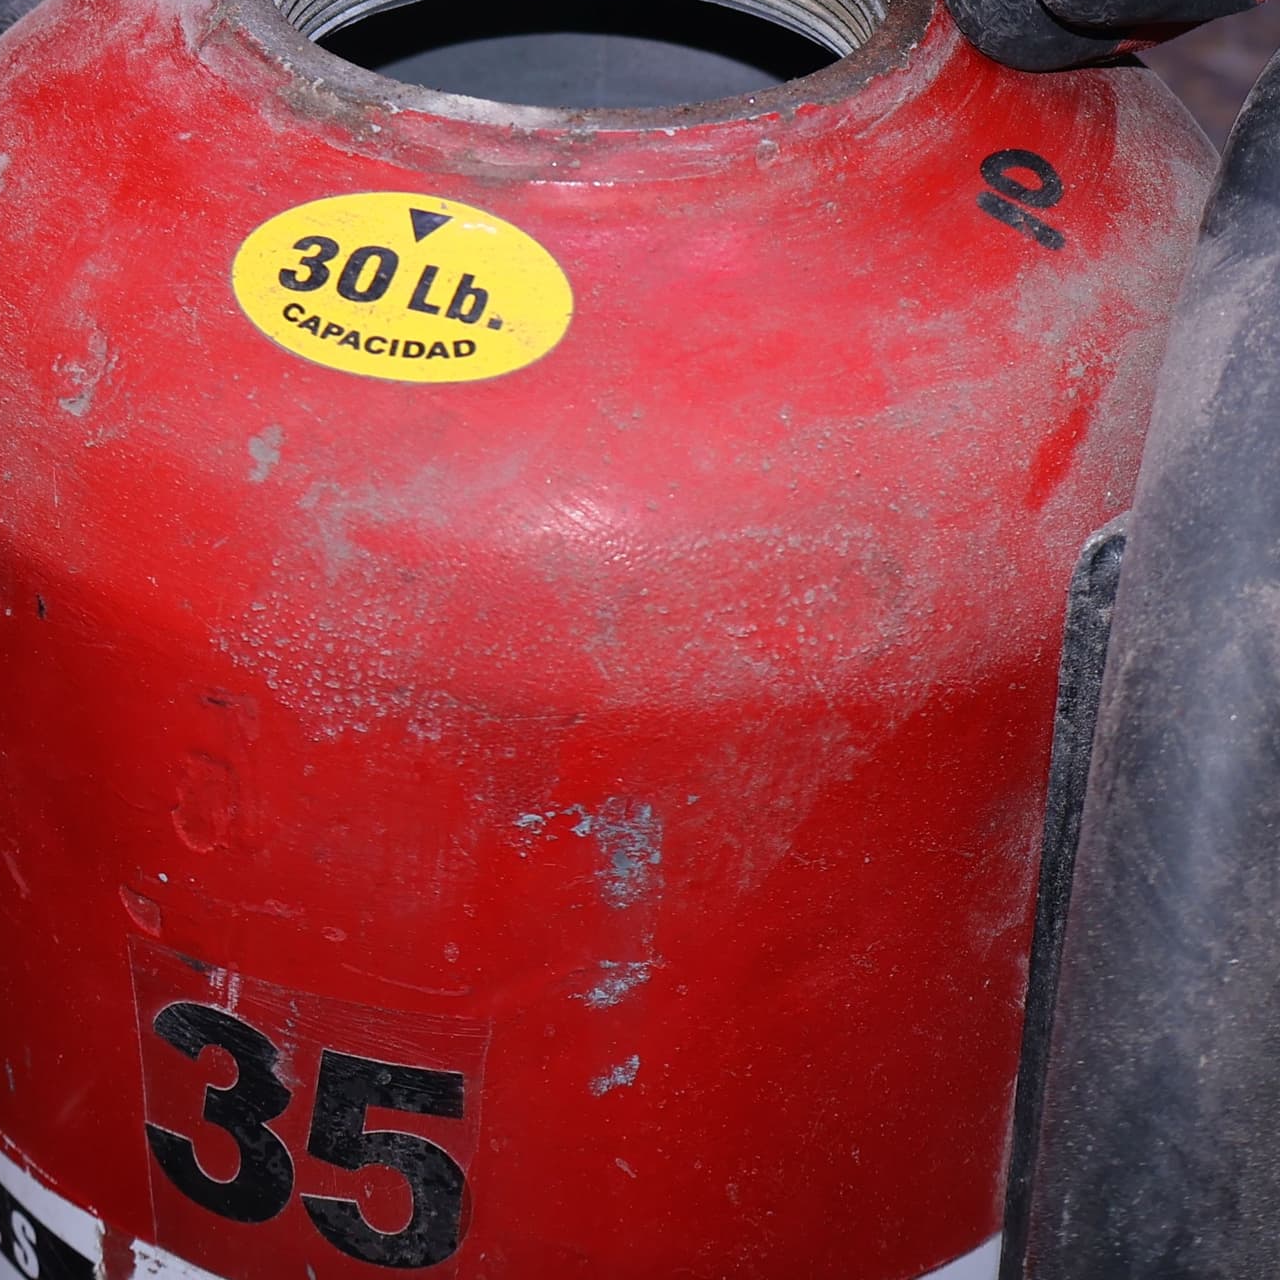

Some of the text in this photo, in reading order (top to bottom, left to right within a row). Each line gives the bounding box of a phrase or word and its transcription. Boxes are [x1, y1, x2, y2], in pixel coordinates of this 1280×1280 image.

[278, 235, 504, 331] 30 Lb.
[281, 303, 477, 360] CAPACIDAD
[145, 1001, 466, 1270] 35
